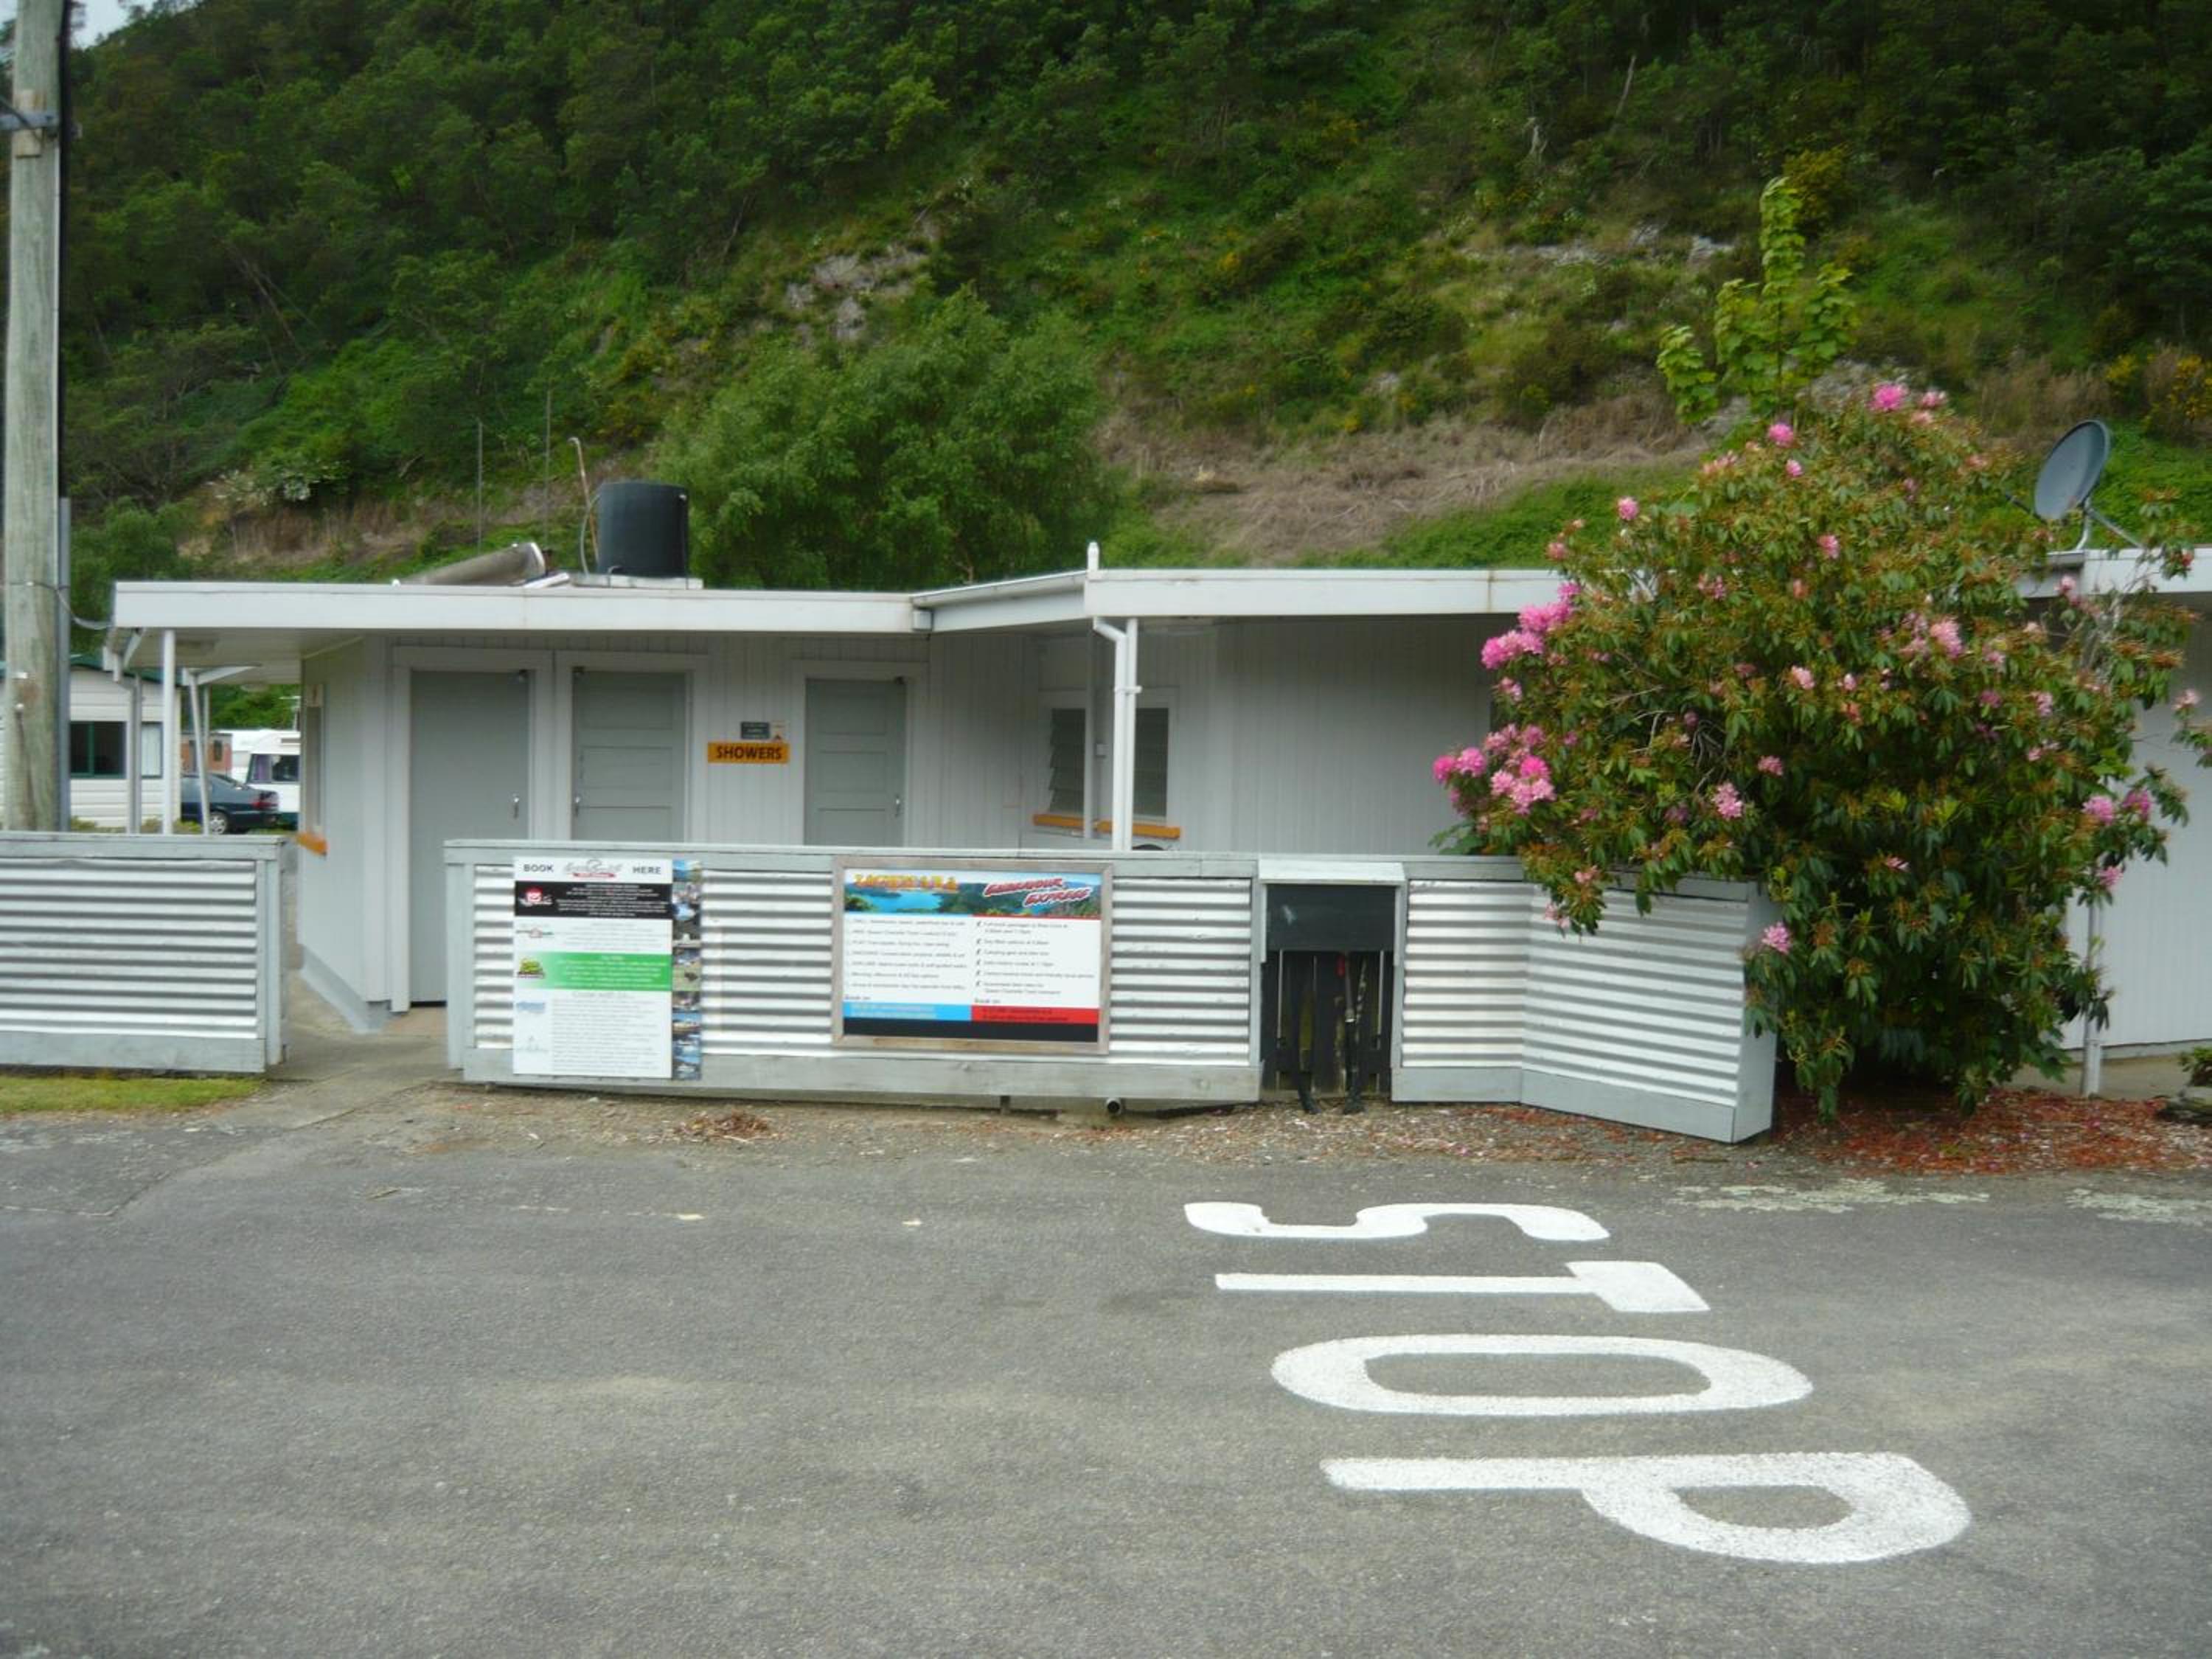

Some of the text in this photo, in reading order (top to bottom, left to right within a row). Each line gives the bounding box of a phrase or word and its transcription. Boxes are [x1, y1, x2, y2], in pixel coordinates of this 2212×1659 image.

[717, 745, 782, 760] SHOWERS
[524, 863, 553, 872] BOOK
[632, 866, 661, 874] HERE
[1184, 1202, 1972, 1563] STOP
